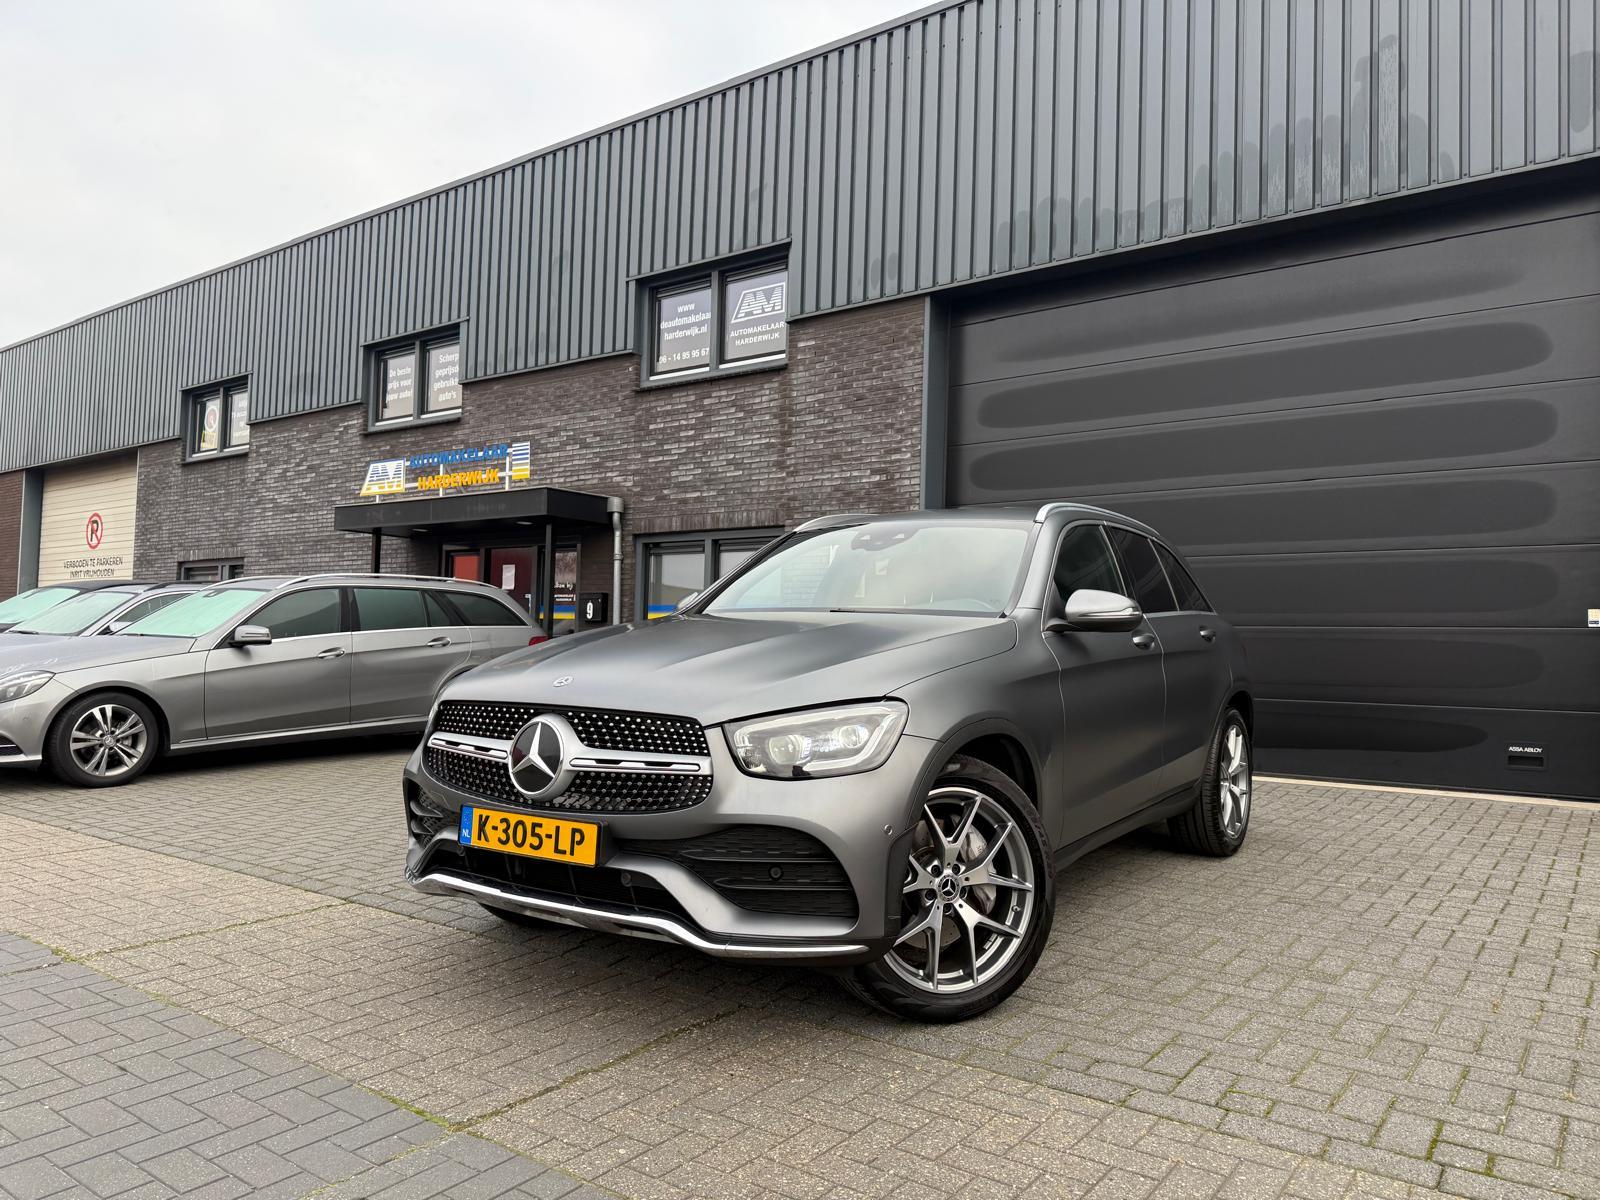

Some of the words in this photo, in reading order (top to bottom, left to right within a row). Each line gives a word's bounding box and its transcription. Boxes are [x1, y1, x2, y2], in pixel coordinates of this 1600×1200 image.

[677, 303, 695, 313] www
[664, 324, 708, 340] harderwijk.nl
[730, 321, 785, 337] AUTOMAKELAAR
[735, 332, 780, 346] HARDERWIJK
[439, 353, 459, 363] Scherp
[673, 352, 681, 361] 14
[682, 351, 690, 360] 95
[691, 348, 700, 358] 95
[439, 390, 456, 401] auto's
[409, 443, 509, 469] AUTOMAKELAAR
[418, 468, 499, 490] HARDERWIJK
[64, 559, 89, 569] VERBODEN
[90, 558, 95, 567] TE
[97, 556, 123, 567] PARKEREN
[70, 570, 82, 578] INRIT
[84, 568, 114, 577] VRIJHOUDEN
[587, 602, 593, 619] 9
[462, 828, 471, 838] NL
[477, 814, 585, 857] K-305-LP
